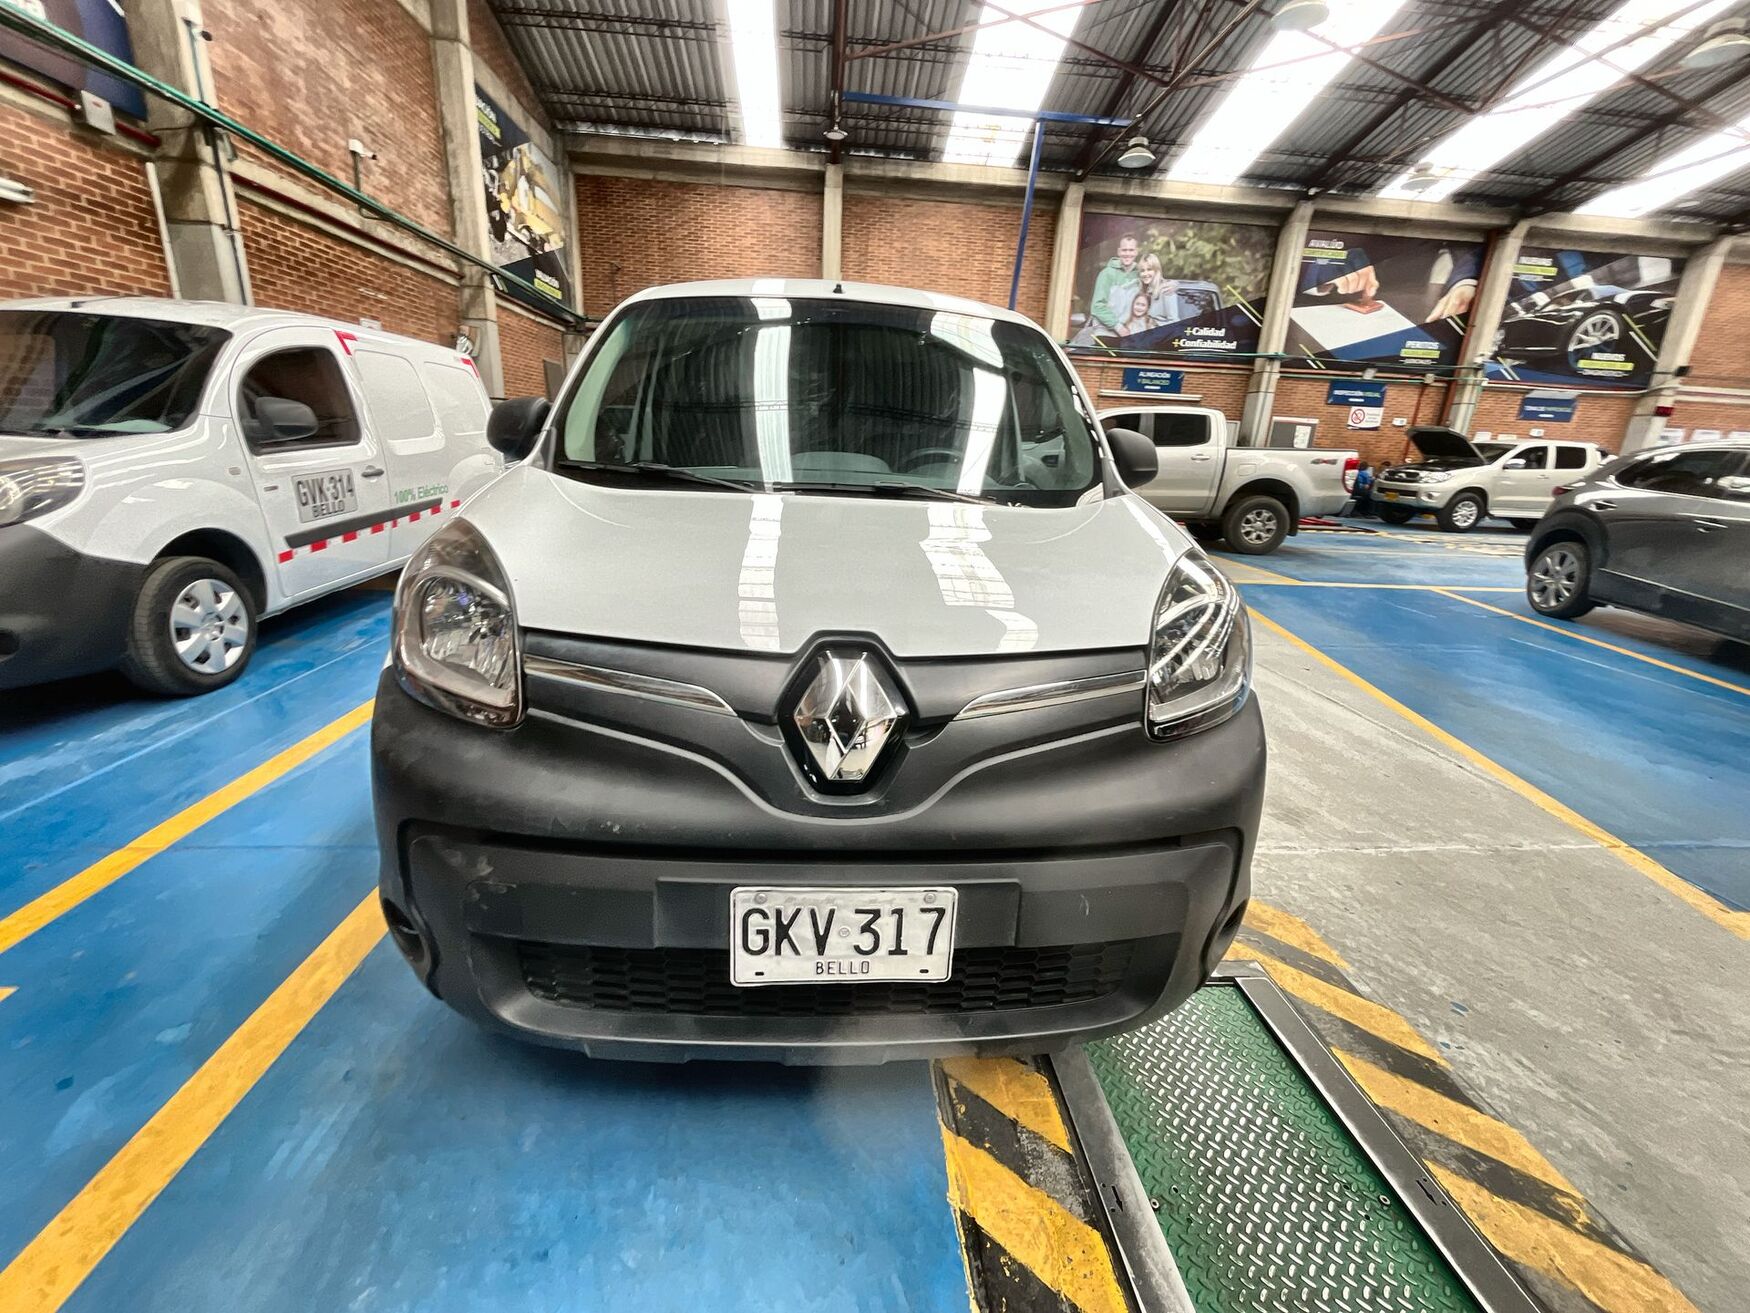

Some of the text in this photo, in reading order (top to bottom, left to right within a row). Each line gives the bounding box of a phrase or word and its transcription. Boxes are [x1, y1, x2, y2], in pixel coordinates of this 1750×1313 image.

[394, 489, 416, 504] 100%
[312, 500, 345, 518] BELLO
[742, 907, 946, 956] GKV 317
[815, 960, 870, 975] BELLO
